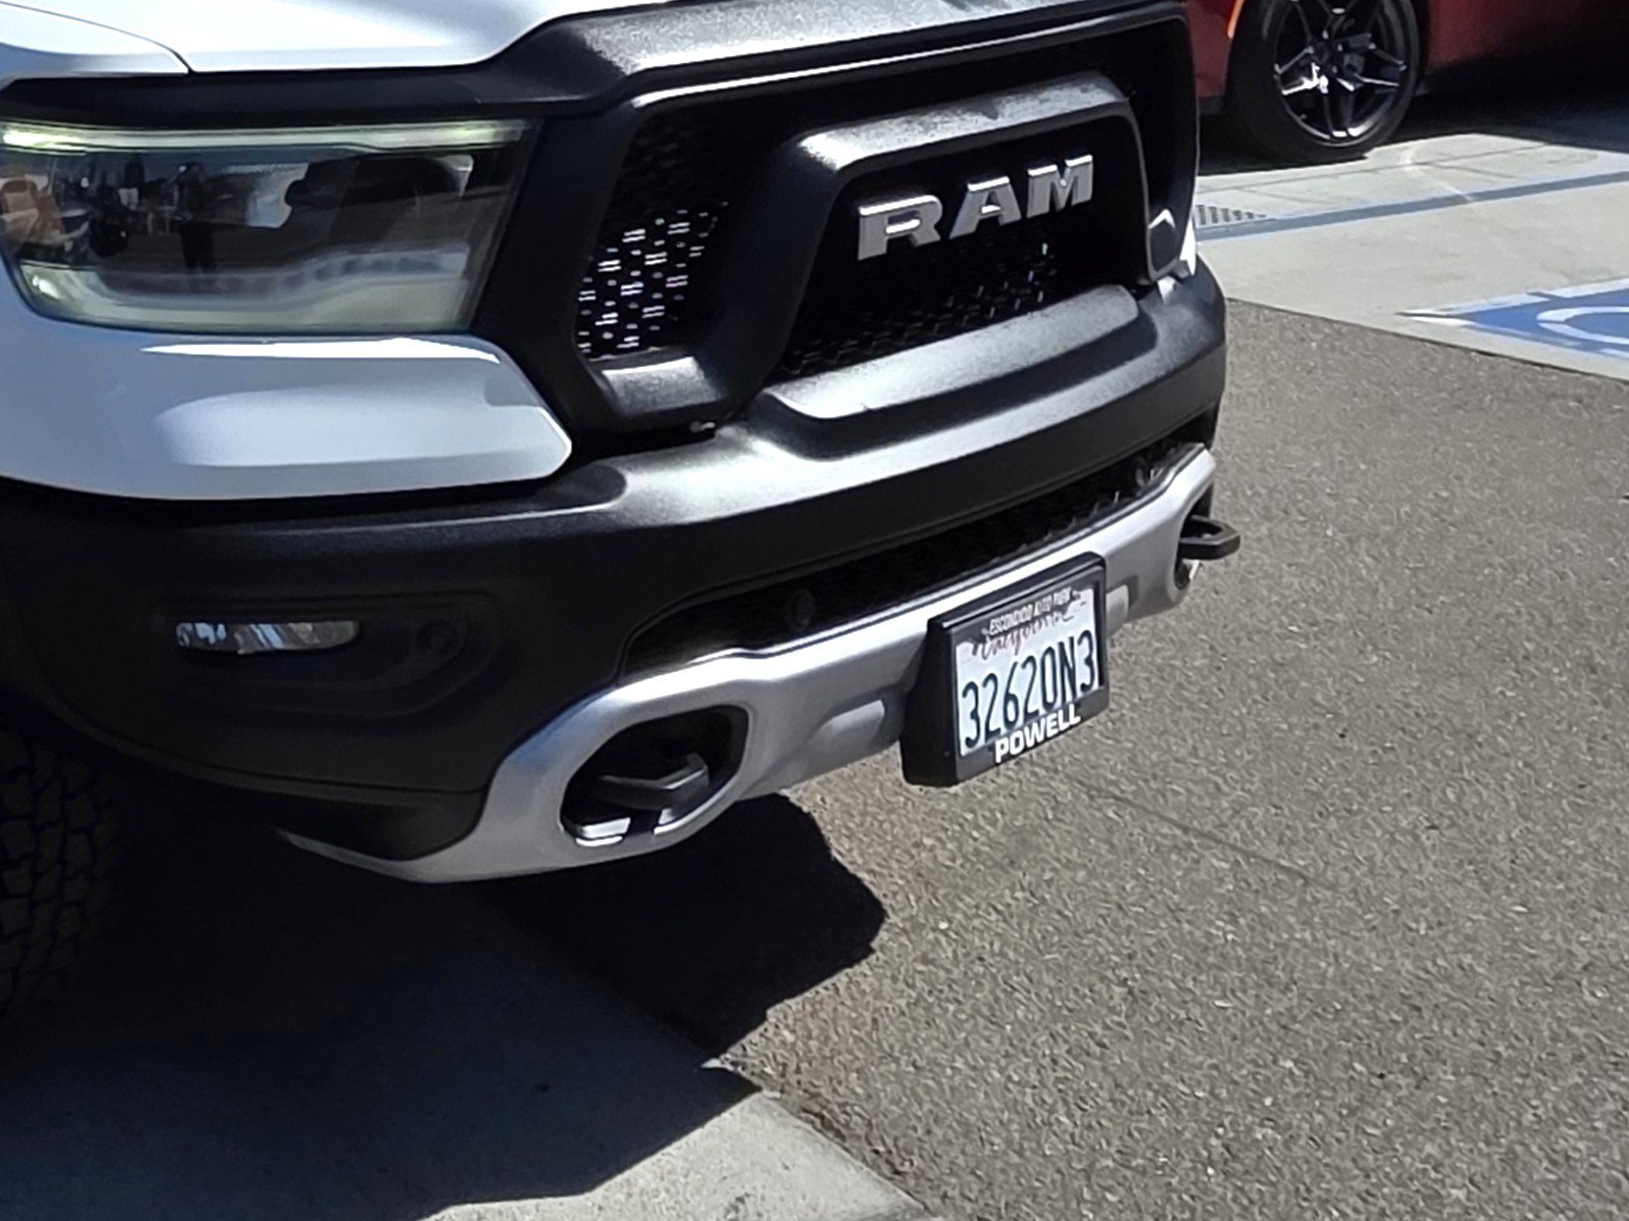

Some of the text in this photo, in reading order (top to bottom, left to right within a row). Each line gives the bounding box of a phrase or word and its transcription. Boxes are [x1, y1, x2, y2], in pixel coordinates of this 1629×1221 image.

[858, 154, 1093, 261] RAM
[962, 630, 1095, 749] 32620N3
[995, 704, 1081, 764] POWELL
